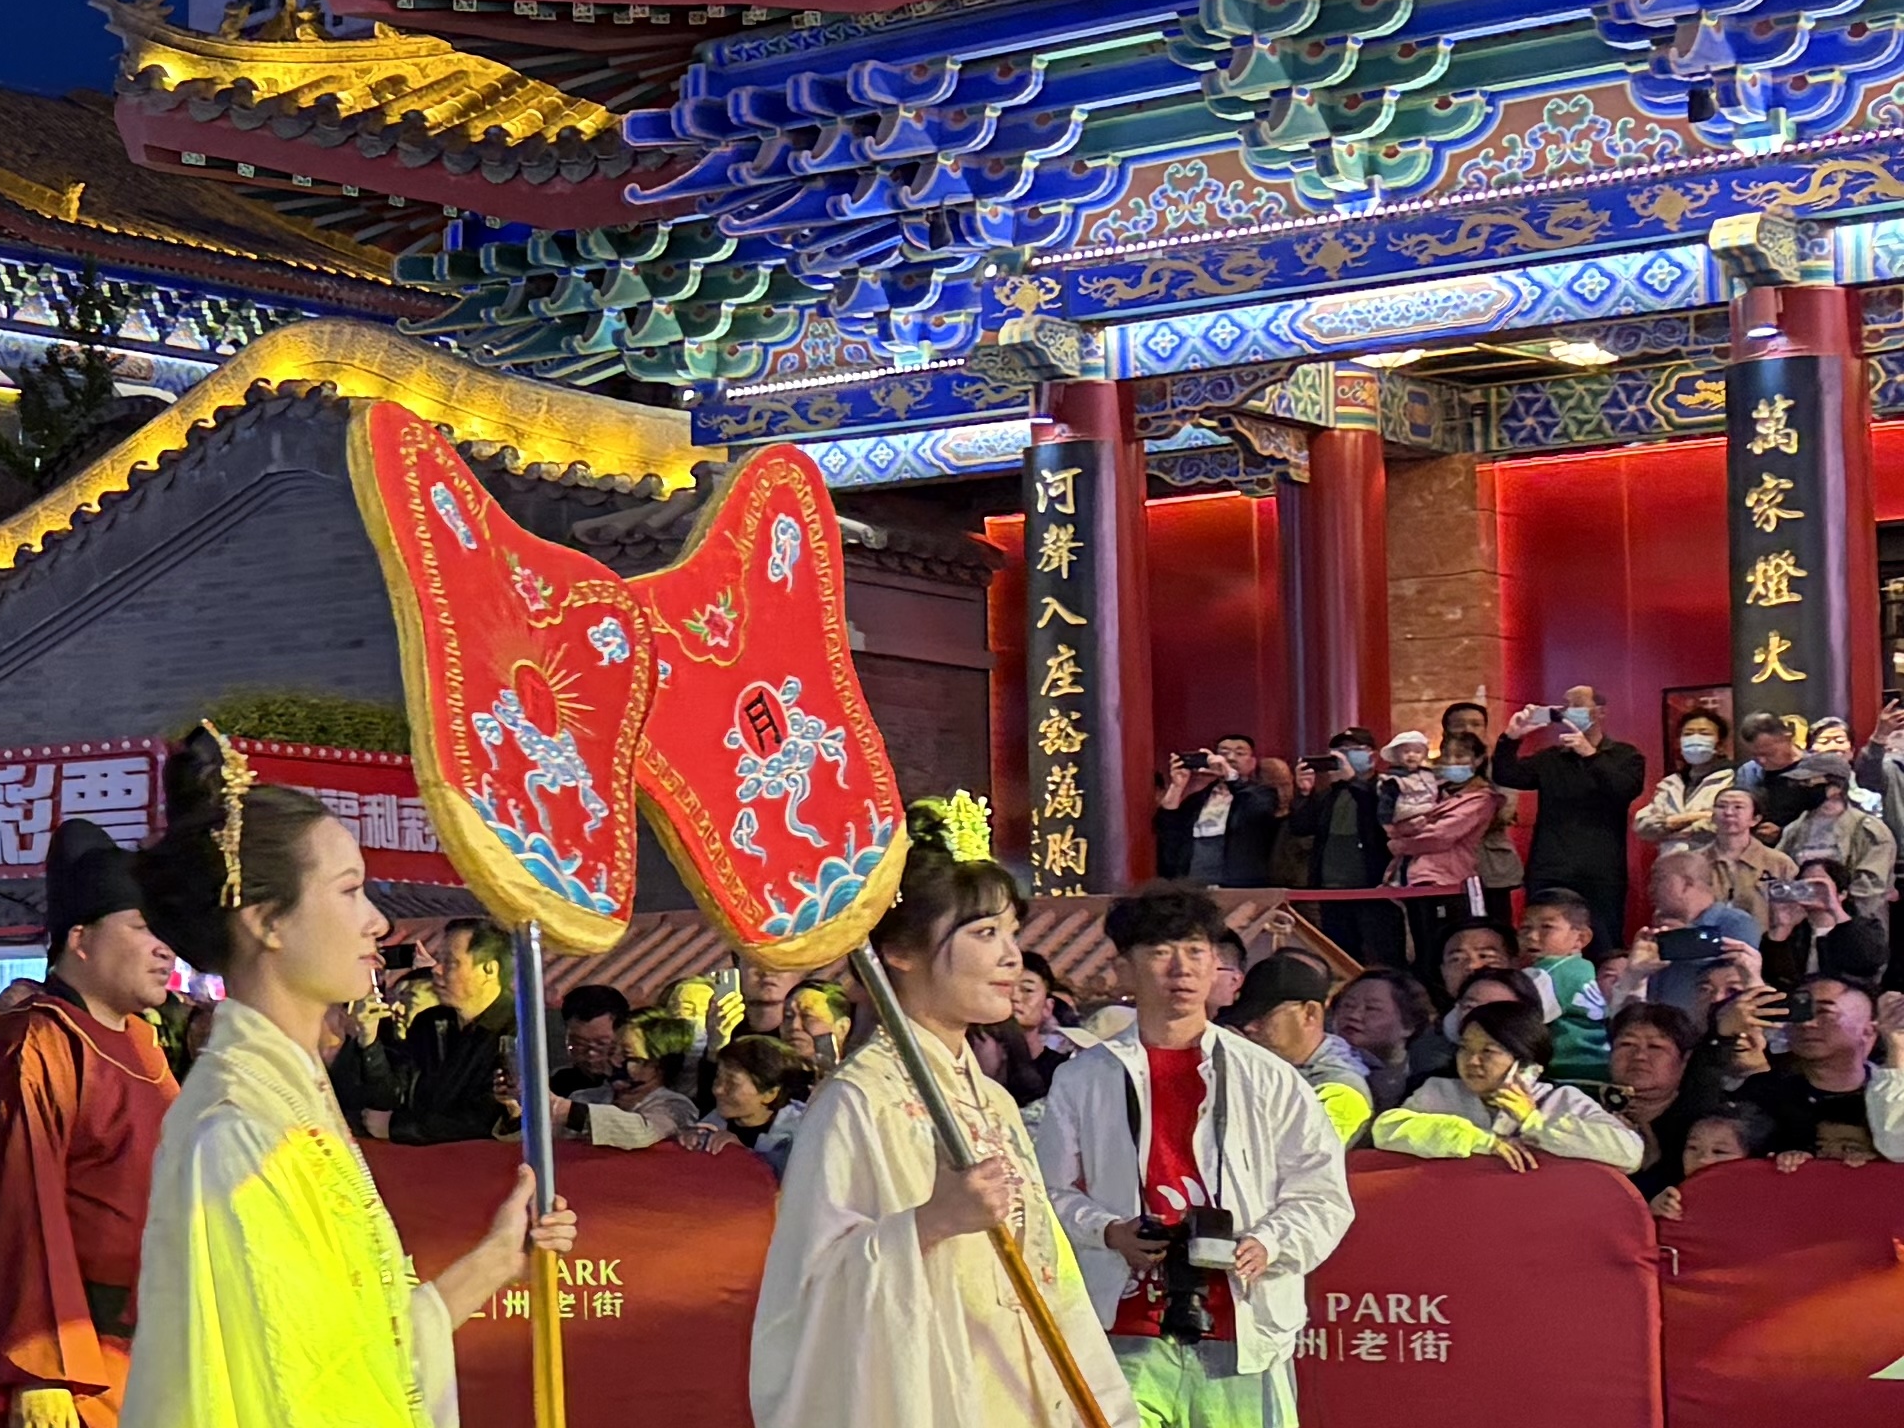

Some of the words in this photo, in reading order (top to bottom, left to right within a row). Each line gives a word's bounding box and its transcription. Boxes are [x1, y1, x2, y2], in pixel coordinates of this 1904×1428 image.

[1745, 394, 1808, 750] 萬家燈火
[1035, 468, 1090, 896] 河聲入座豁蕩胸
[557, 1258, 624, 1286] ARK
[1325, 1292, 1451, 1324] PARK
